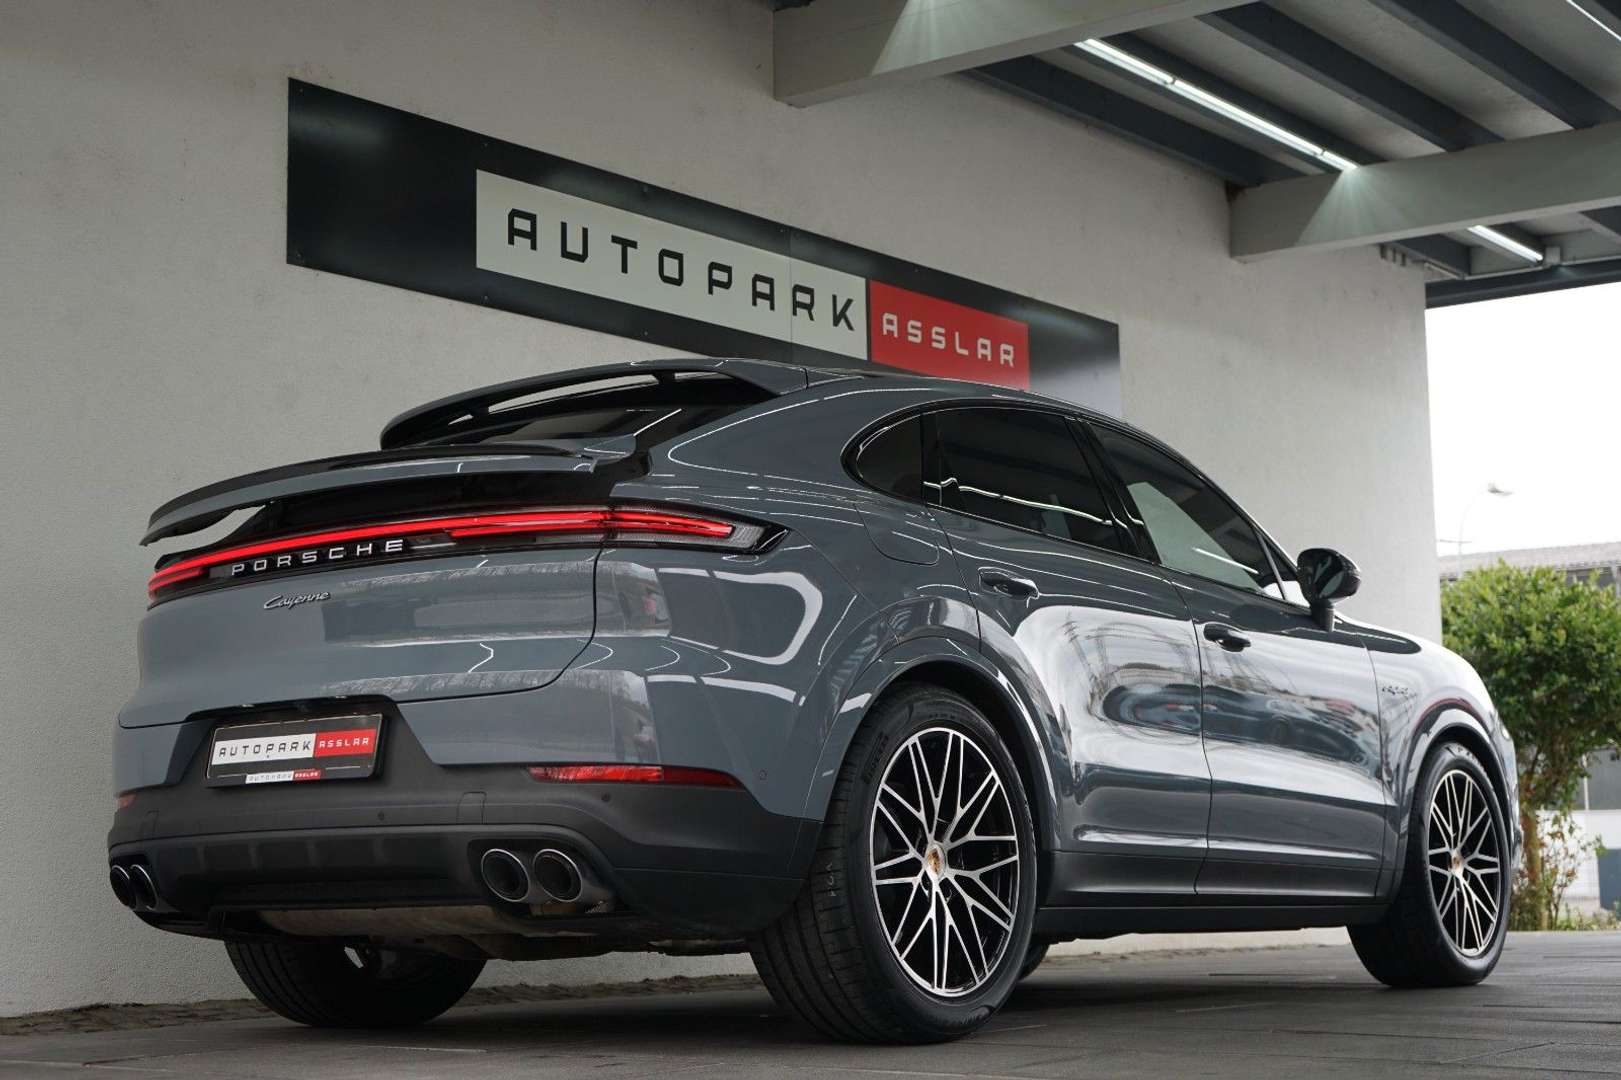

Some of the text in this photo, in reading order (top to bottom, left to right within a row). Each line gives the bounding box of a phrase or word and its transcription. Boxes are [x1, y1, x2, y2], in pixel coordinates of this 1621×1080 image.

[507, 207, 1015, 368] AUTOPARK ASSLAR
[231, 539, 404, 576] PORSCHE
[263, 591, 331, 610] Cayenne
[218, 737, 370, 758] AUTOPARK ASSLAR
